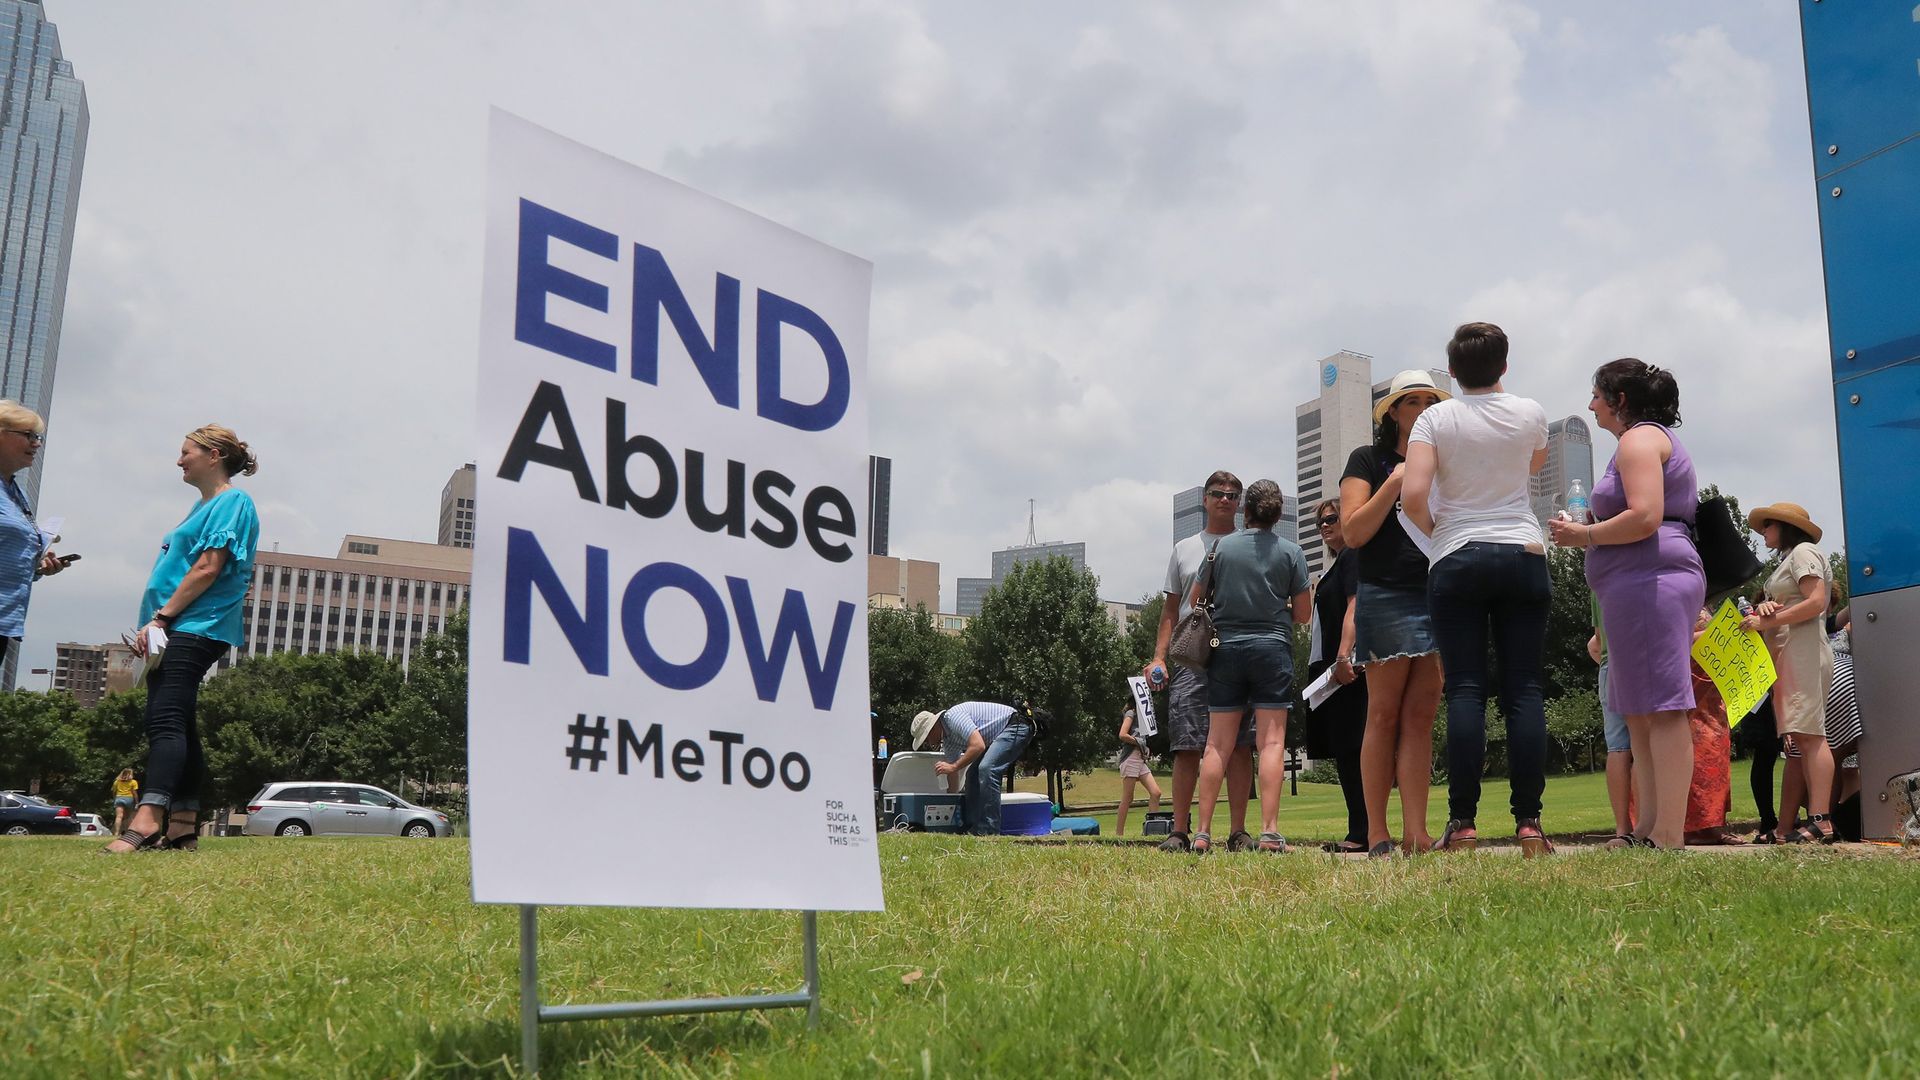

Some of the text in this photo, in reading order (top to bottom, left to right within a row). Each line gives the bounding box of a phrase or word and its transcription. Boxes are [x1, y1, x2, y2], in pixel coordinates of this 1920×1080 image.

[514, 196, 851, 433] END
[495, 379, 857, 564] Abuse
[502, 525, 857, 712] NOW
[1721, 607, 1759, 662] Protect
[1709, 626, 1733, 653] not
[1699, 645, 1727, 679] snap
[1135, 682, 1156, 731] END
[565, 712, 812, 793] #MeToo
[826, 800, 844, 810] FOR
[826, 812, 858, 822] SUCH A
[828, 824, 861, 835] TIME AS
[828, 836, 848, 846] THIS
